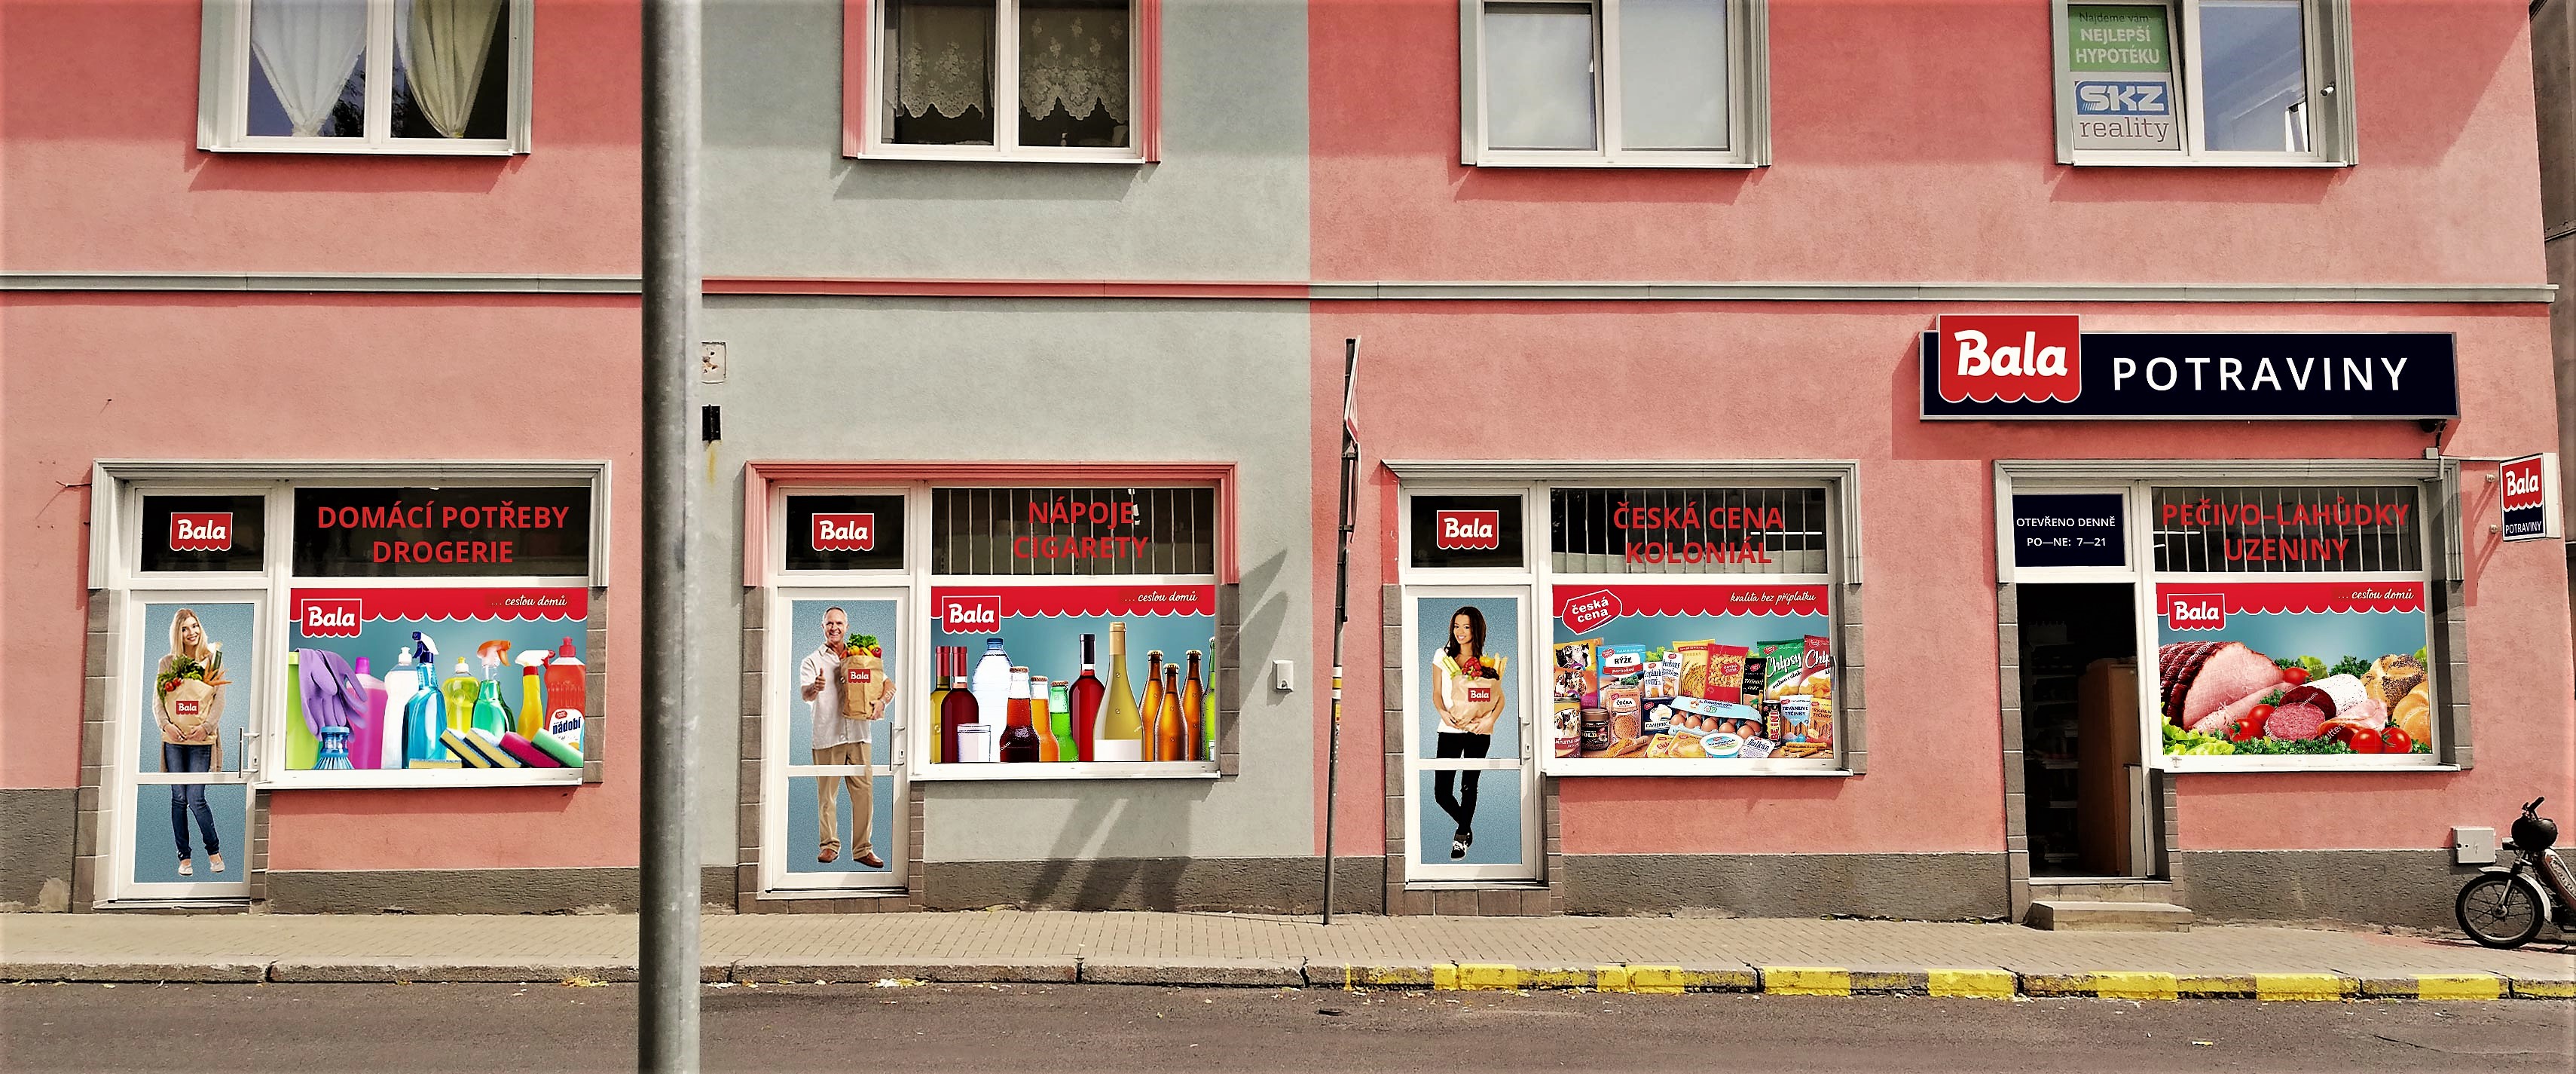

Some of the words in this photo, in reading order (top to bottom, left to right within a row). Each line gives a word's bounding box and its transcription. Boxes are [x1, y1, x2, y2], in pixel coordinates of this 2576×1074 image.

[2079, 11, 2125, 24] Najdeme
[2127, 13, 2149, 23] vám
[2080, 25, 2151, 44] NEJLEPŠÍ
[2075, 45, 2159, 64] HYPOTÉKU
[2080, 85, 2165, 112] SKZ
[2079, 117, 2169, 142] reality
[1954, 329, 2068, 377] Bala
[2113, 356, 2408, 391] POTRAVINY
[2505, 467, 2539, 497] Bala
[318, 500, 435, 528] DOMÁCÍ
[442, 500, 570, 528] POTŘEBY
[1028, 496, 1135, 529] NÁPOJE
[1613, 501, 1701, 529] ČESKÁ
[1709, 506, 1785, 529] CENA
[2016, 516, 2075, 527] OTEVŘENO
[2078, 516, 2116, 527] DENNĚ
[177, 519, 227, 540] Bala
[819, 520, 869, 540] Bala
[1444, 517, 1493, 538] Bala
[2505, 521, 2542, 534] POTRAVINY
[373, 541, 513, 563] DROGERIE
[1013, 536, 1149, 558] CIGARETY
[1626, 536, 1772, 564] KOLONIÁL
[2225, 538, 2350, 561] UZENINY
[505, 596, 535, 607] cestou
[537, 594, 567, 607] domů
[1138, 592, 1168, 602] cestou
[1169, 590, 1198, 602] domů
[1730, 592, 1759, 603] kvalita
[1760, 592, 1774, 602] bez
[1774, 591, 1817, 605] příplatku
[2351, 587, 2382, 600] cestou
[2383, 588, 2415, 600] domů
[949, 603, 995, 624] Bala
[1572, 596, 1609, 615] česká
[1577, 608, 1609, 623] cena
[2174, 601, 2220, 621] Bala
[307, 606, 356, 627] Bala
[1614, 656, 1633, 665] RÝŽE
[1766, 653, 1802, 678] Chipsy
[851, 671, 869, 680] Bala
[1471, 690, 1489, 699] Bala
[179, 702, 197, 711] Bala
[552, 716, 581, 735] nádobí
